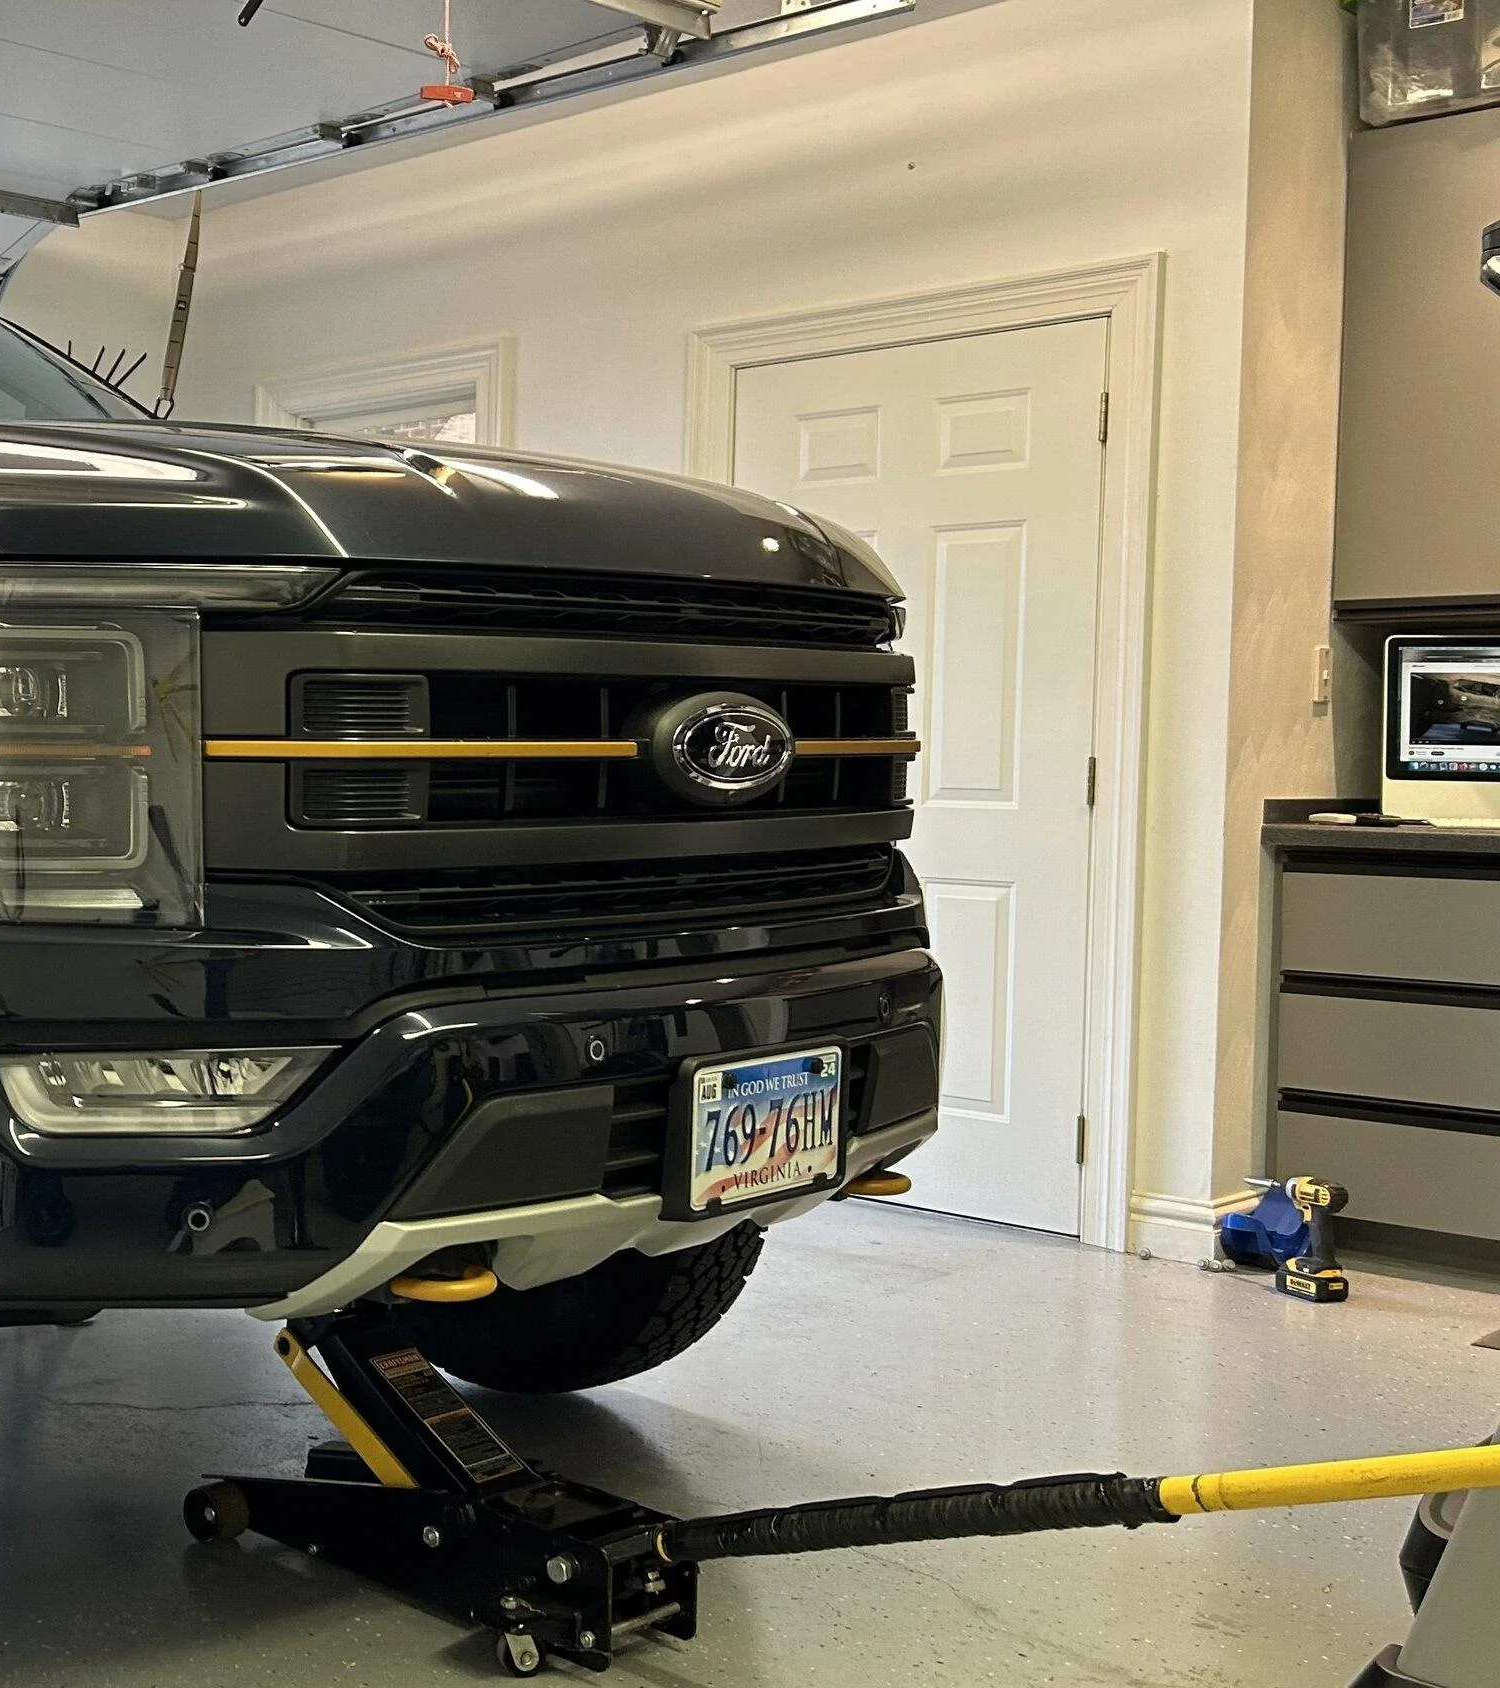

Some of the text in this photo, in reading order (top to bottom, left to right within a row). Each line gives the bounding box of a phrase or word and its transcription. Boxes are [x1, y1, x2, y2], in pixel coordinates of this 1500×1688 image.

[708, 721, 771, 768] Ford
[820, 1061, 836, 1078] 24
[701, 1082, 718, 1100] AUG
[740, 1079, 765, 1097] GOD
[764, 1076, 781, 1092] WE
[781, 1071, 810, 1090] TRUST
[705, 1087, 836, 1172] 769-76HM
[733, 1160, 802, 1191] VIRGINIA
